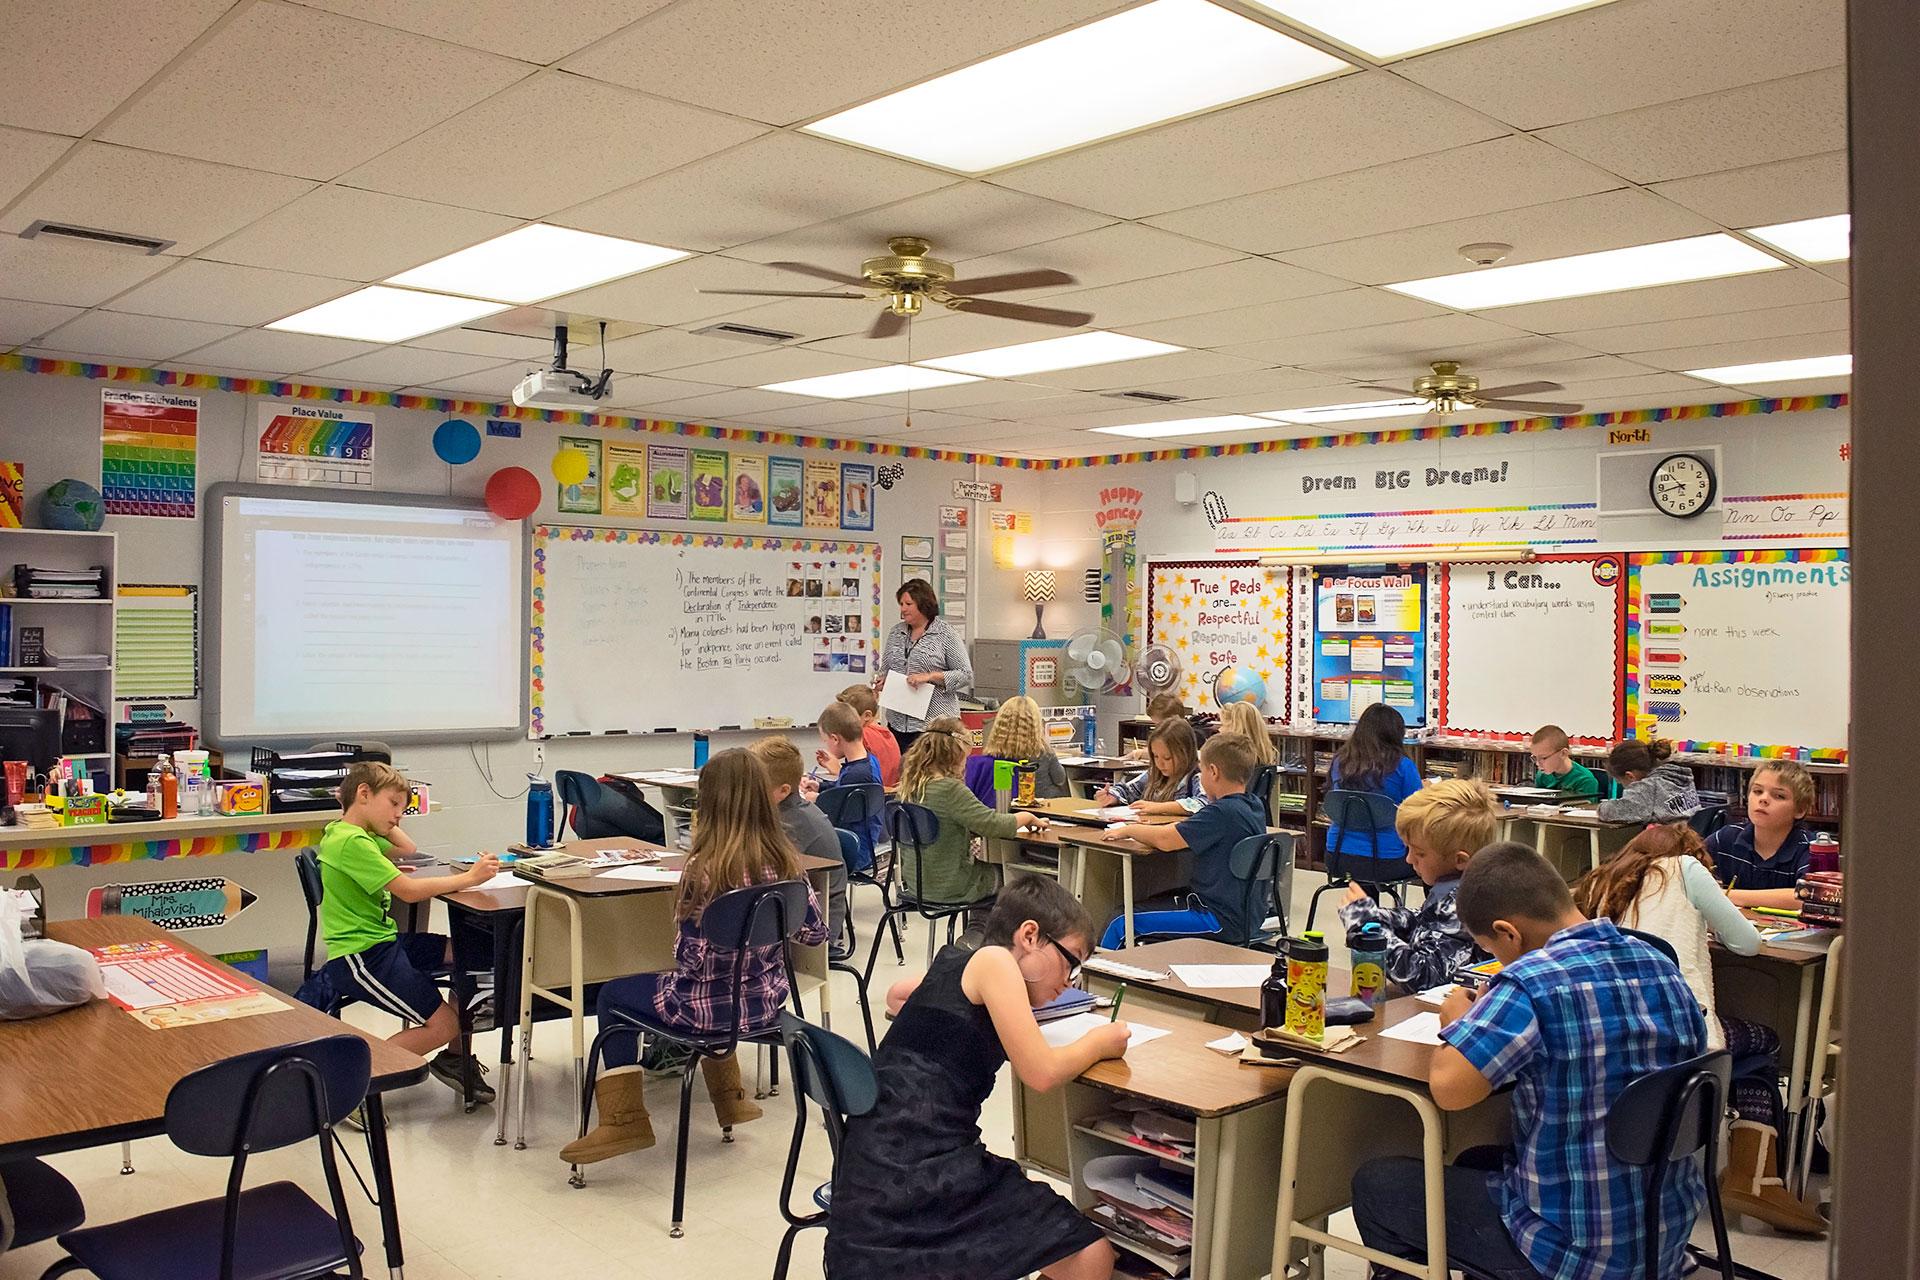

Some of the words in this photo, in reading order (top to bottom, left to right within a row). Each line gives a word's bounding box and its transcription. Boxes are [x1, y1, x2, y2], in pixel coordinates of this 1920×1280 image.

[144, 394, 198, 408] Equivalents
[292, 407, 316, 417] Place
[317, 410, 344, 420] Value
[1609, 428, 1650, 444] North
[265, 441, 271, 451] 1
[281, 442, 289, 452] 5
[298, 443, 305, 454] 6
[313, 444, 320, 454] 4
[329, 446, 337, 456] 7
[345, 447, 353, 458] 9
[361, 448, 368, 459] 8
[1668, 465, 1675, 473] 11
[1676, 461, 1686, 470] 12
[1302, 475, 1357, 494] Dream
[1374, 470, 1411, 489] BIG
[1425, 461, 1509, 487] Dreams!
[1660, 474, 1669, 482] 10
[1695, 471, 1702, 479] 2
[958, 481, 989, 491] Paragraph
[1658, 483, 1665, 492] 9
[1699, 480, 1706, 488] 3
[963, 489, 988, 499] Writing
[1099, 486, 1144, 506] Happy
[1695, 491, 1703, 499] 4
[1669, 500, 1676, 508] 7
[1679, 502, 1686, 510] 6
[1688, 498, 1695, 507] 5
[1095, 507, 1144, 528] Dance!
[1562, 513, 1597, 529] Mm
[1726, 508, 1760, 523] Nn
[1770, 506, 1796, 522] Oo
[1808, 504, 1840, 528] Pp
[687, 571, 701, 584] The
[702, 574, 735, 585] members
[737, 571, 747, 587] of
[749, 572, 761, 585] the
[1347, 577, 1381, 589] Focus
[1382, 575, 1410, 588] Wall
[1487, 570, 1496, 590] I
[1503, 570, 1561, 590] Can...
[1692, 565, 1851, 589] Assignments
[683, 585, 718, 598] Continental
[721, 586, 749, 601] Congress
[753, 586, 772, 597] wrote
[775, 586, 785, 596] the
[1190, 578, 1219, 595] True
[1229, 578, 1261, 596] Reds
[725, 600, 732, 612] of
[737, 600, 778, 611] Independence
[1467, 599, 1509, 611] understand
[1511, 599, 1548, 616] vocabulary
[1552, 597, 1573, 609] words
[1576, 599, 1595, 614] using
[1198, 611, 1260, 629] Respectful
[1472, 610, 1497, 620] context
[680, 626, 700, 646] Many
[702, 624, 733, 638] colonists
[736, 622, 749, 635] had
[750, 622, 768, 633] been
[772, 620, 796, 637] hoping
[1191, 631, 1258, 646] Responsible
[1693, 626, 1718, 638] none
[1725, 625, 1747, 639] this
[1752, 626, 1781, 638] week
[680, 642, 691, 656] for
[735, 640, 753, 651] since
[764, 638, 782, 649] event
[785, 635, 803, 647] called
[24, 655, 39, 664] SEE
[680, 658, 692, 670] the
[697, 656, 719, 670] Boston
[723, 656, 732, 668] Tea
[735, 653, 751, 671] Party
[1209, 649, 1238, 666] Safe
[1202, 671, 1220, 685] Ca
[1693, 681, 1731, 694] Acid-Rain
[1737, 685, 1800, 699] observations
[74, 816, 95, 824] Ever
[151, 895, 177, 906] Mrs.
[132, 903, 196, 919] Mihalovich
